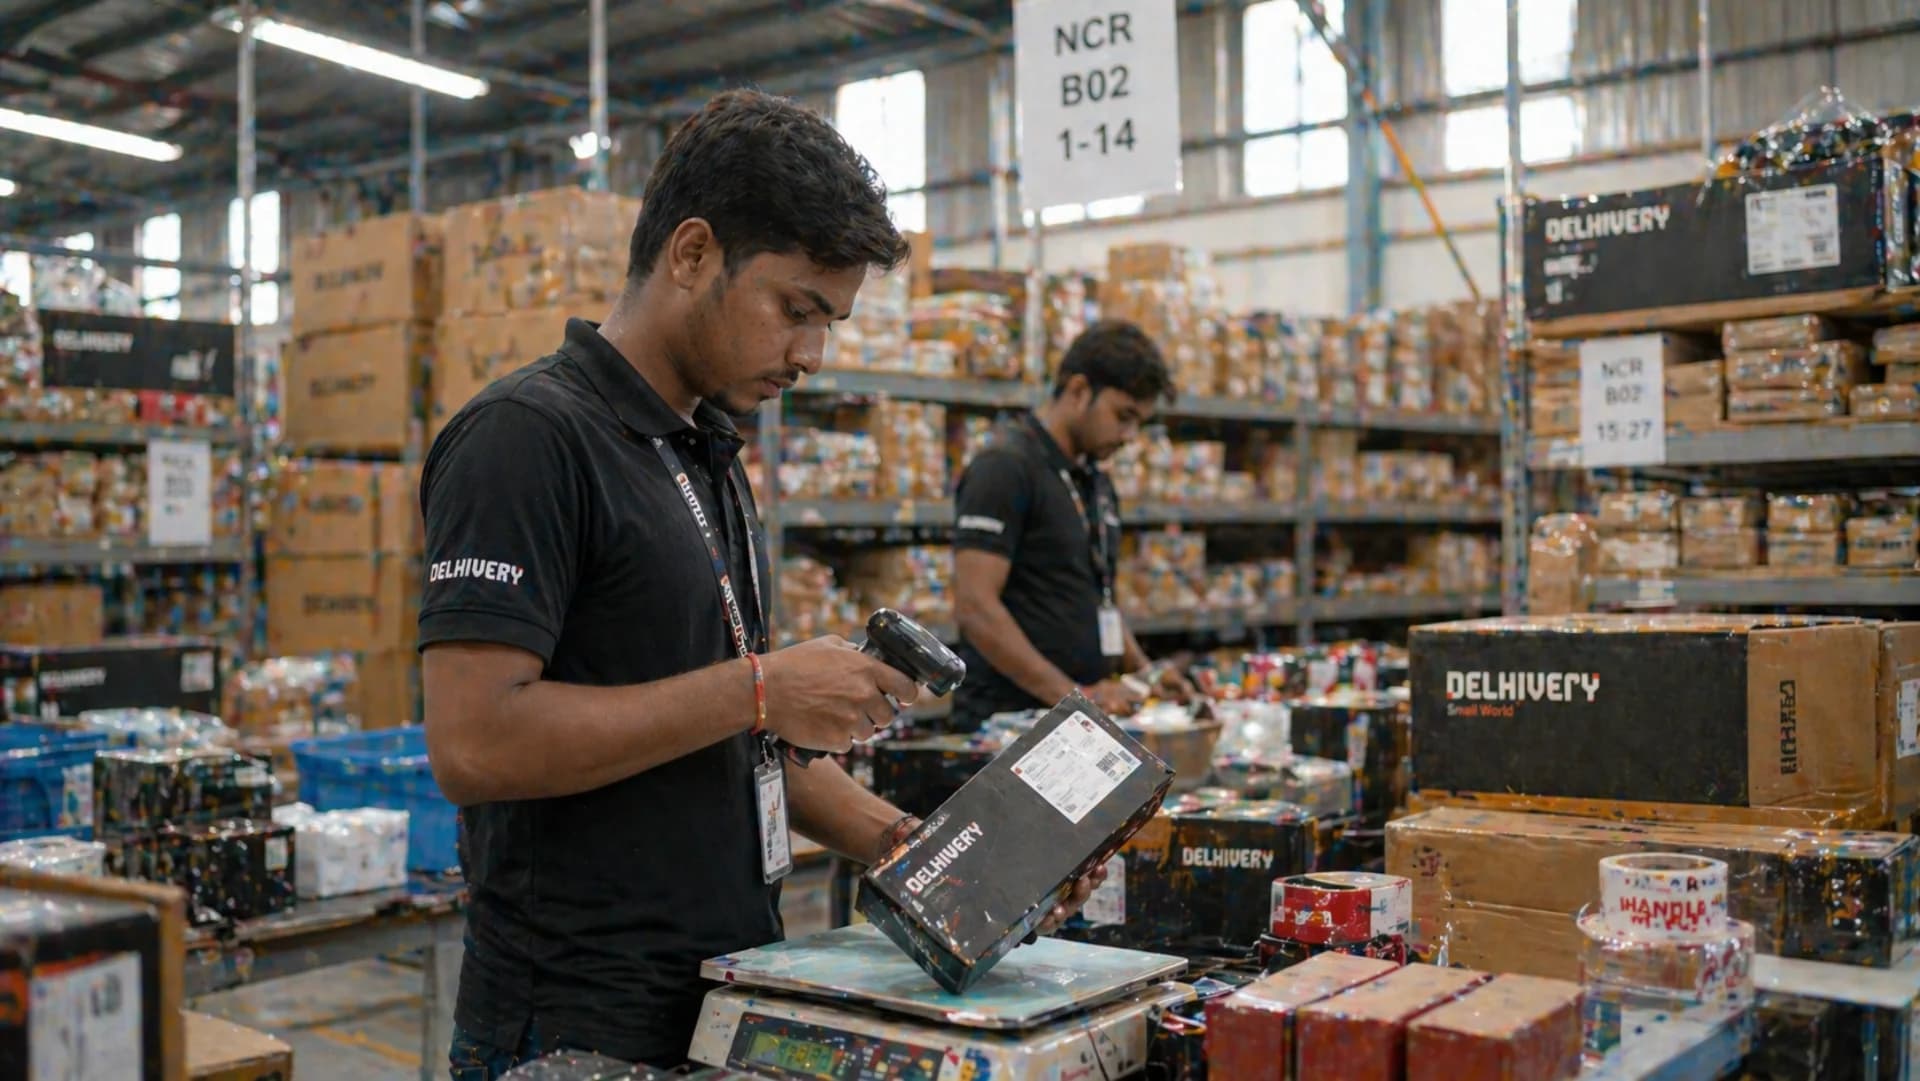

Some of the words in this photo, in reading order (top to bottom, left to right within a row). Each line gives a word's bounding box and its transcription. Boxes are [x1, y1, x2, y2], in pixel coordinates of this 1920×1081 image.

[1054, 12, 1133, 56] NCR
[1061, 65, 1130, 108] B02
[1058, 117, 1137, 160] 1-14
[1545, 203, 1670, 243] DELHIVERY
[429, 557, 524, 585] DELHIVERY
[1446, 670, 1601, 703] DELHIVERY
[905, 820, 984, 896] DELHIVERY
[1182, 846, 1275, 870] DELHIVERY
